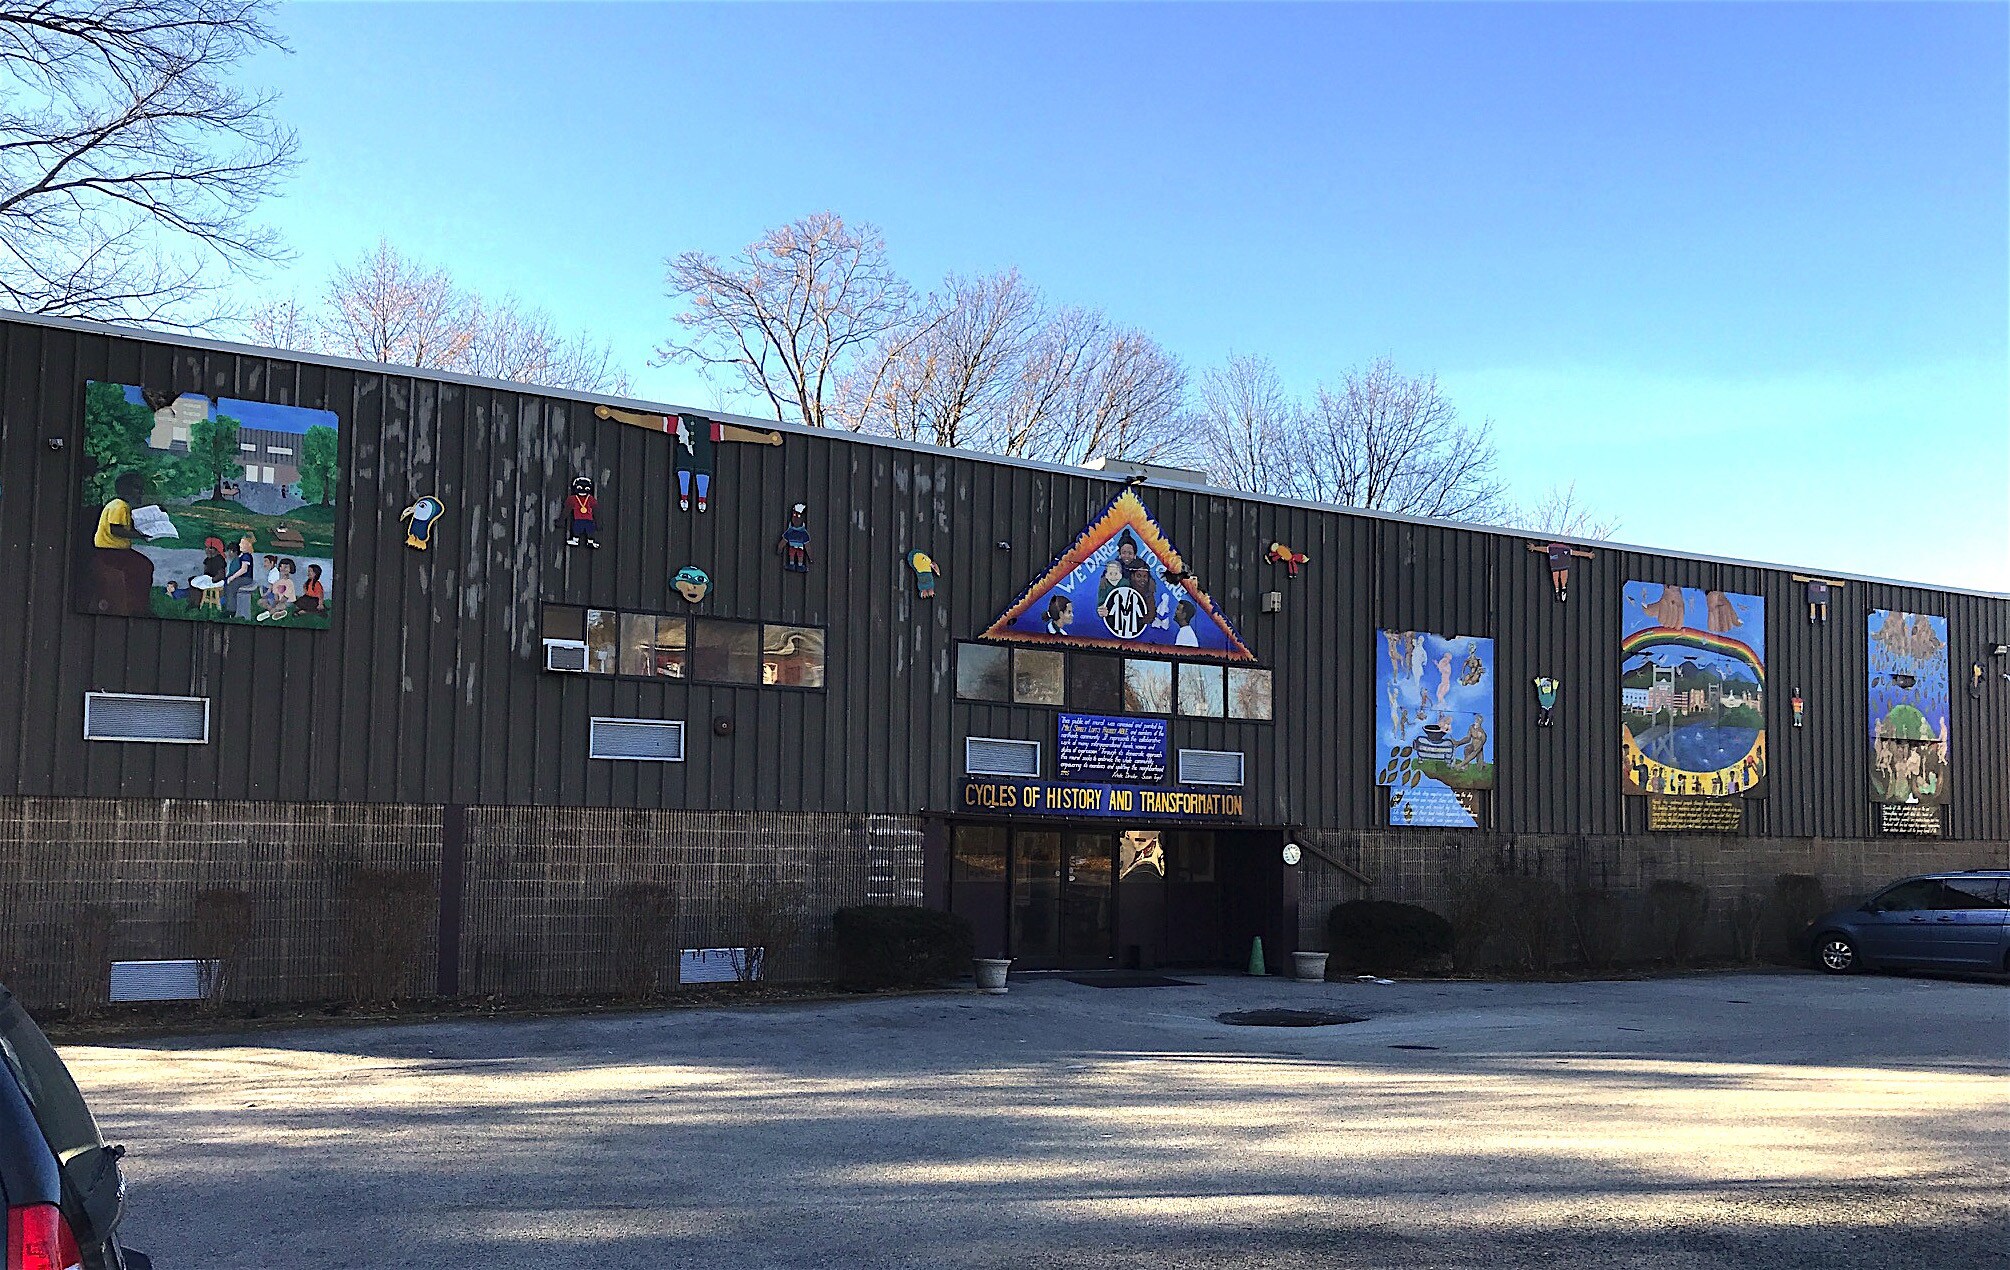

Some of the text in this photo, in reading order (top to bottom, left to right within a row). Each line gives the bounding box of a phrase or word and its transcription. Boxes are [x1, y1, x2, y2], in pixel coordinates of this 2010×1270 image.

[1055, 538, 1120, 594] WE DARE
[1140, 543, 1158, 568] TO
[965, 784, 1244, 816] CYCLES OF HISTORY AND TRANSFORMATION
